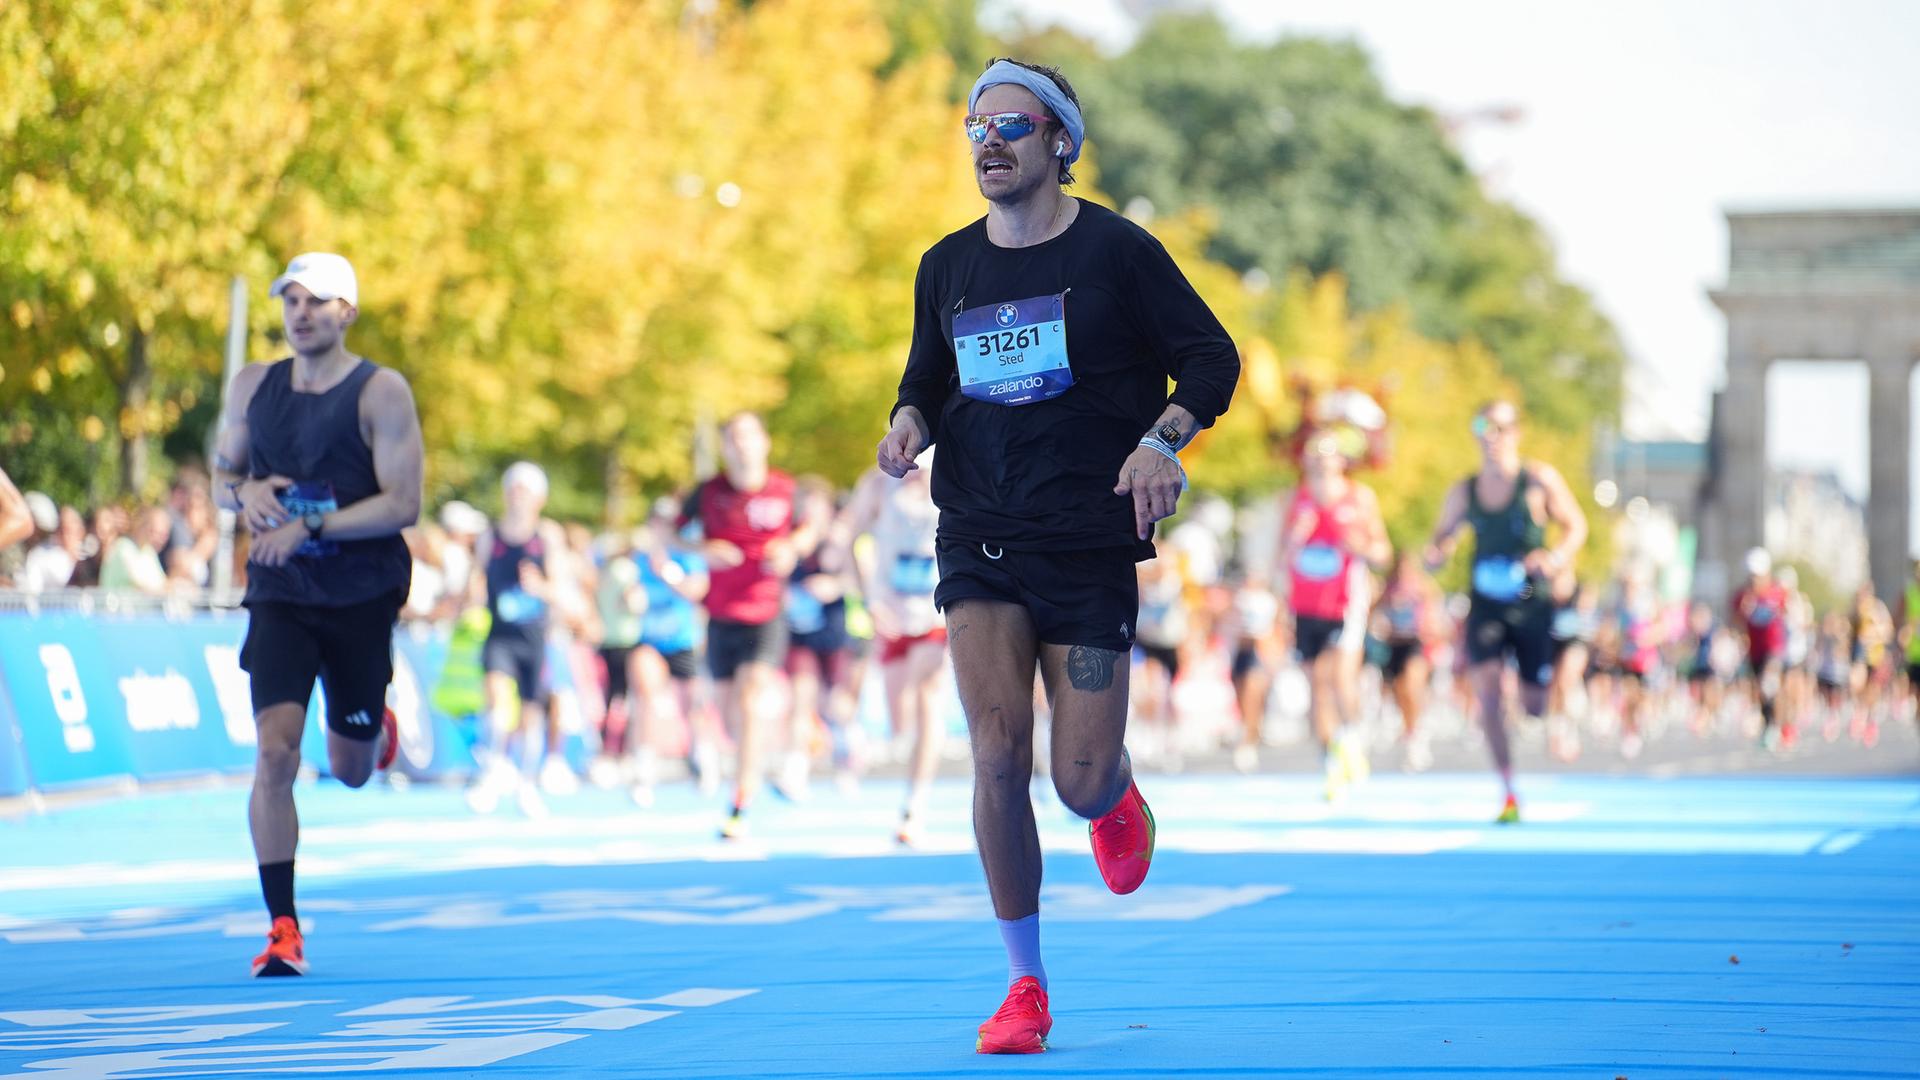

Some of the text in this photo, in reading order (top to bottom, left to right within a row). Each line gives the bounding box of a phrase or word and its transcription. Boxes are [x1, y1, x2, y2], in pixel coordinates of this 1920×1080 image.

[1053, 325, 1059, 333] C
[977, 326, 1040, 356] 31261
[998, 352, 1024, 366] Sted
[988, 376, 1043, 396] zalando
